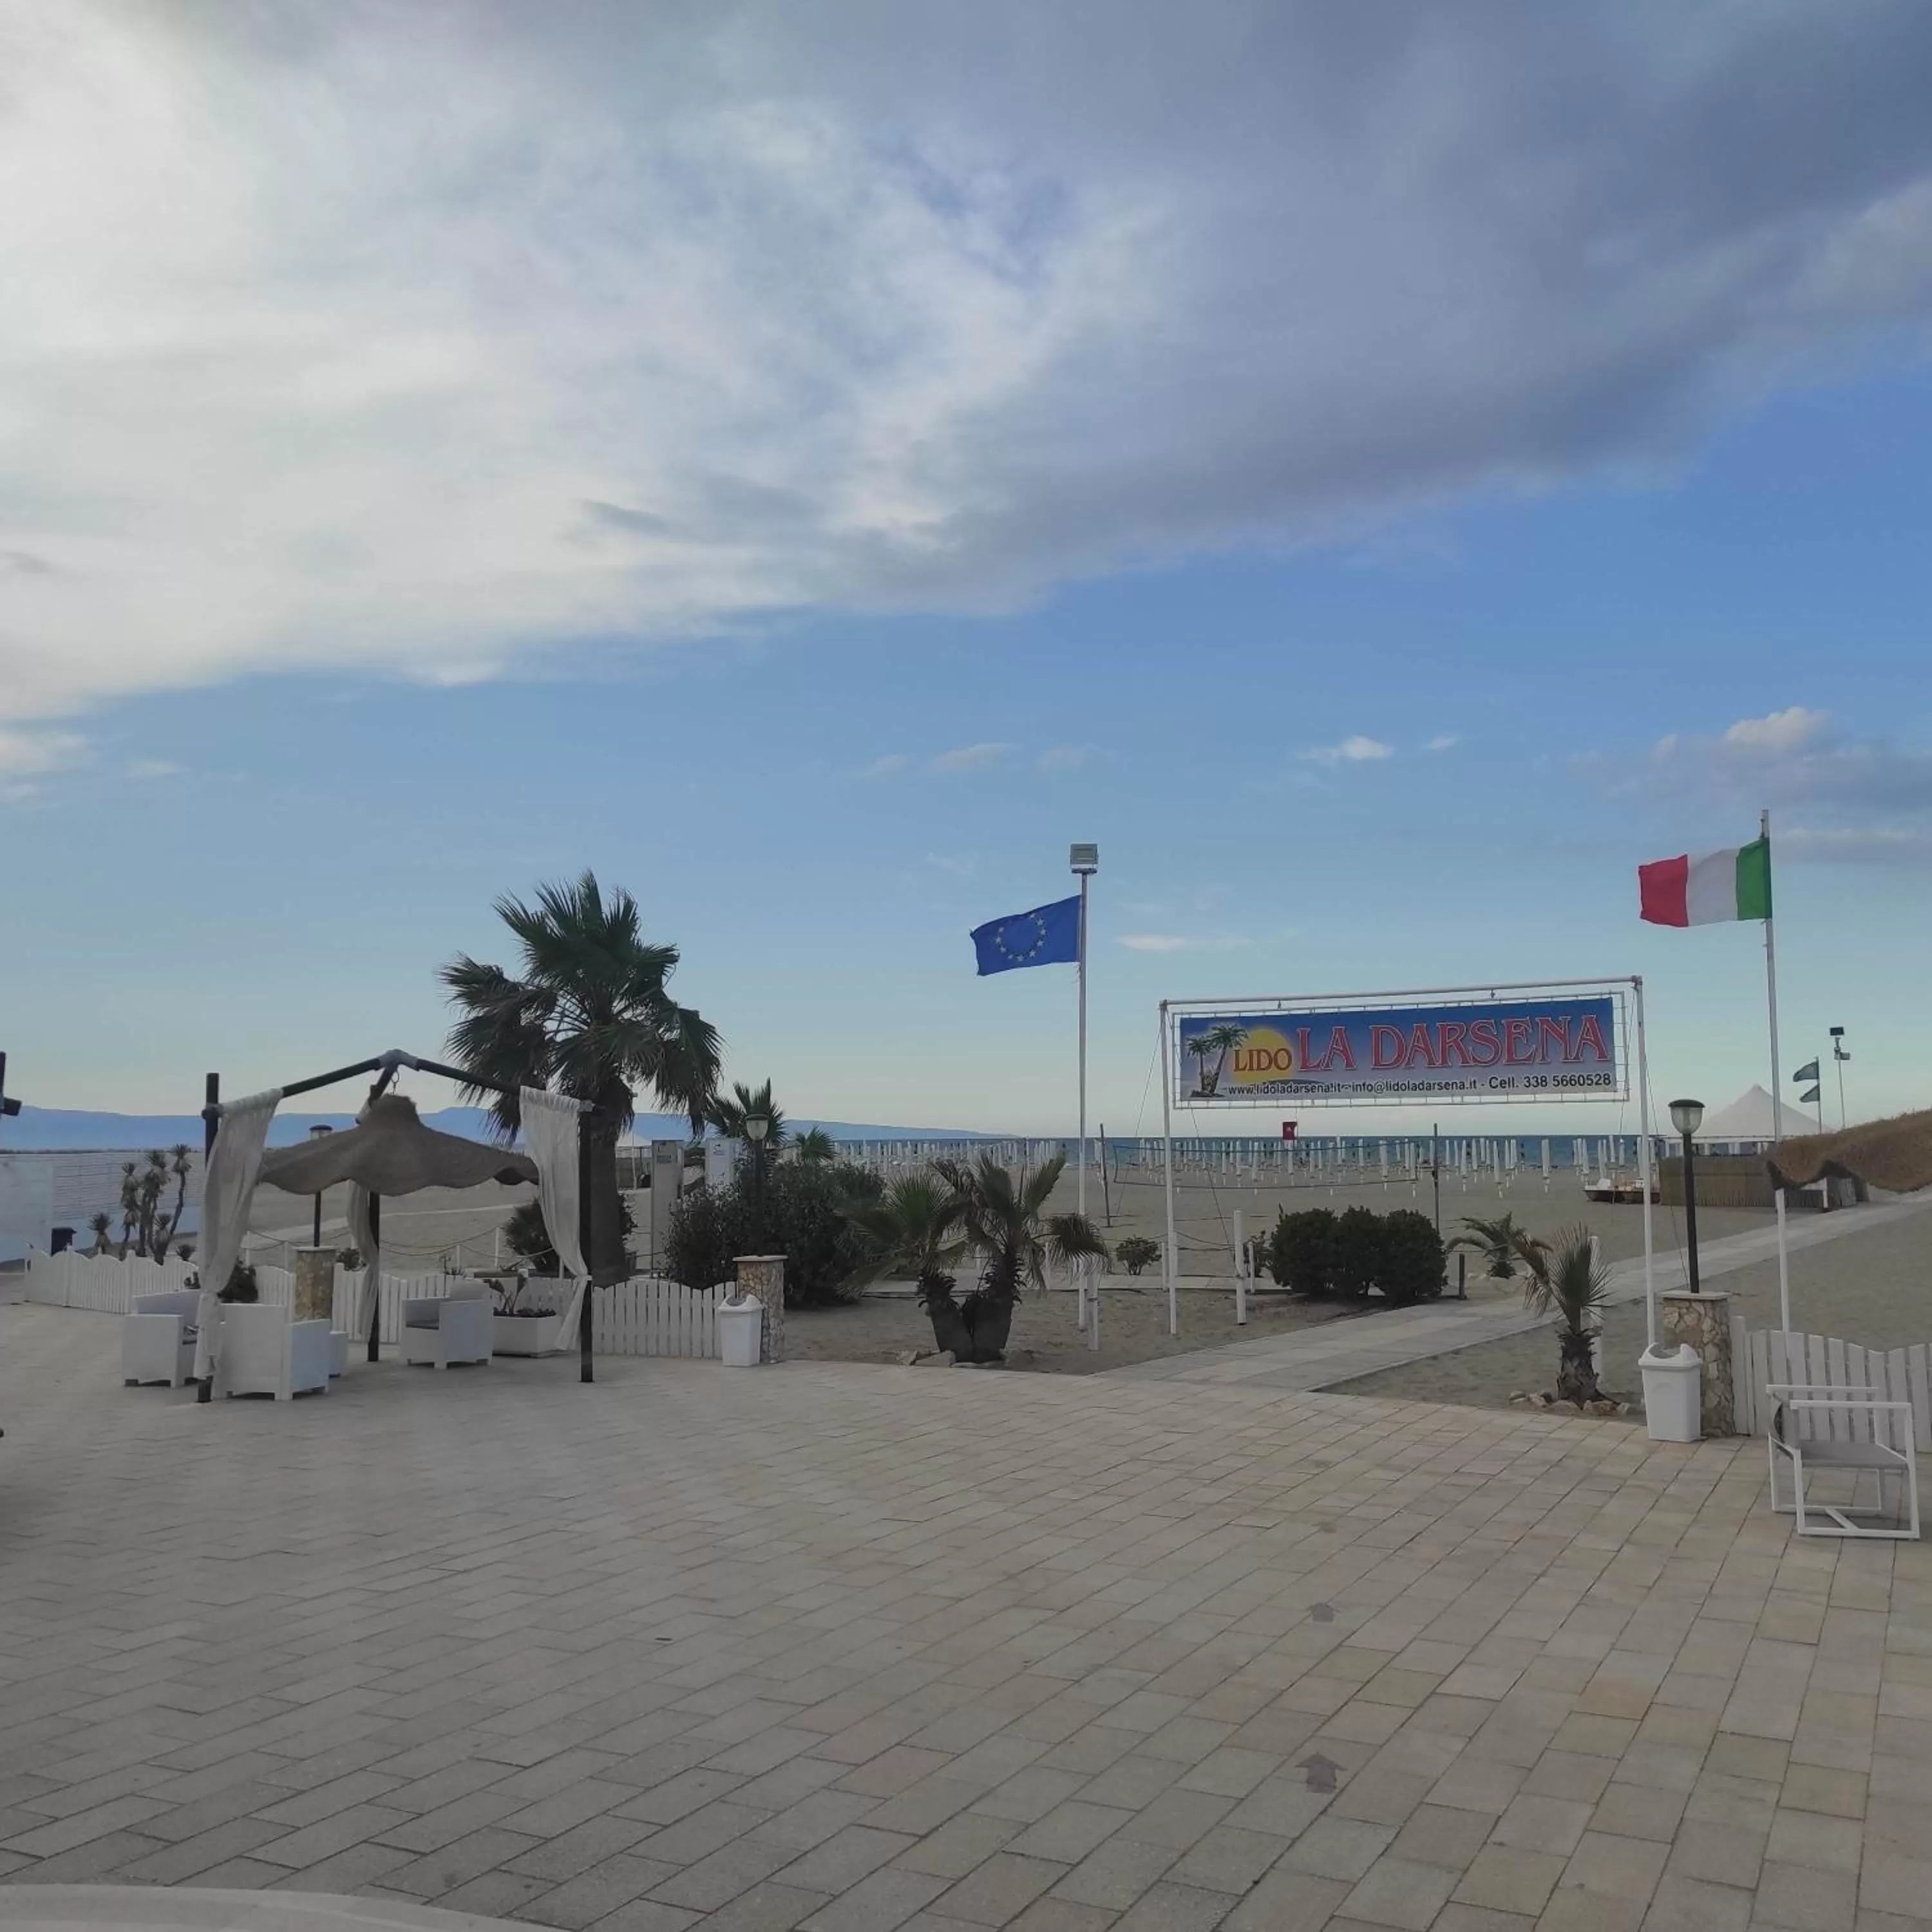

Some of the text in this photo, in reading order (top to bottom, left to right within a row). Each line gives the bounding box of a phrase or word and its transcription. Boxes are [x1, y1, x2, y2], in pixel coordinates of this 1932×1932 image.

[1233, 1014, 1611, 1073] LIDO LA DARSENA
[1352, 1079, 1477, 1093] info@lidoladarsena.it
[1488, 1076, 1519, 1089] Cell.
[1523, 1075, 1548, 1088] 338
[1552, 1072, 1611, 1087] 5660528
